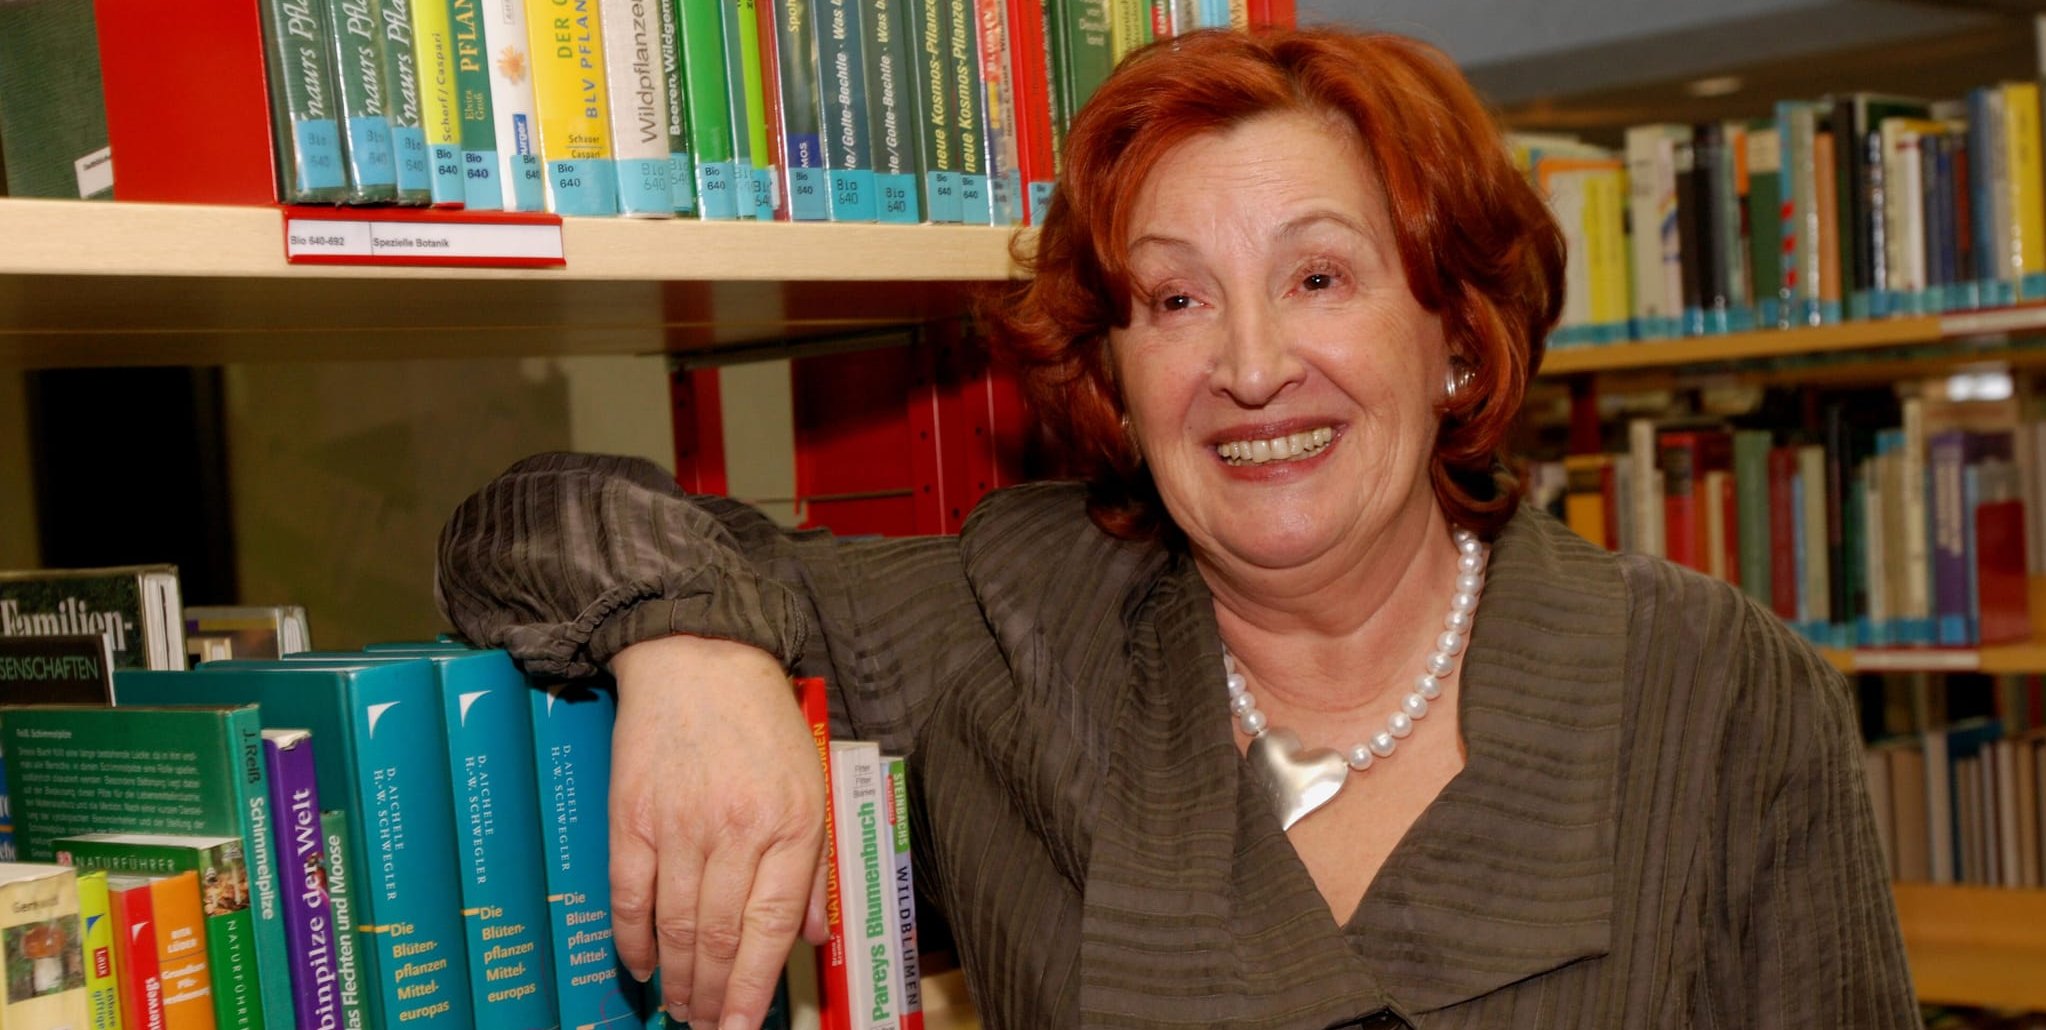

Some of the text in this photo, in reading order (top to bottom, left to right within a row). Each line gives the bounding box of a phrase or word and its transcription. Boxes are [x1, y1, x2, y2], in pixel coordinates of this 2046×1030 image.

[832, 9, 846, 40] Was
[877, 13, 889, 43] Was
[554, 17, 573, 59] DER
[432, 33, 446, 86] Caspari
[358, 46, 382, 118] naurs
[632, 0, 658, 144] Wildpflanze
[300, 47, 325, 121] naurs
[582, 78, 599, 118] BLV
[437, 149, 452, 159] Bio
[466, 153, 482, 163] Bio
[935, 129, 948, 170] neue
[962, 133, 976, 173] neue
[438, 165, 458, 175] 640
[467, 169, 489, 179] 640
[557, 164, 574, 173] Bio
[705, 167, 720, 176] Bio
[560, 178, 581, 188] 640
[707, 181, 726, 190] 640
[837, 178, 857, 191] Bio
[886, 187, 904, 198] Bio
[937, 187, 952, 196] 640
[839, 193, 858, 205] 640
[963, 190, 979, 199] 640
[887, 201, 906, 212] 640
[290, 236, 306, 245] Bio
[373, 238, 449, 248] Spezielle Botanik
[563, 745, 577, 823] D. AICHELE
[478, 755, 494, 836] D. AICHELE
[387, 768, 404, 850] D. AICHELE
[894, 772, 909, 846] STEINBACHS
[243, 729, 256, 743] J.
[250, 797, 274, 920] Schimmelpilze
[292, 788, 315, 856] Welt
[554, 785, 571, 871] SCHWEGLER
[469, 796, 487, 884] SCHWEGLER
[75, 855, 175, 870] NATURFÜHRER
[378, 810, 397, 900] SCHWEGLER
[857, 802, 884, 939] Blumenbuch
[303, 863, 321, 908] der
[563, 892, 585, 906] Die
[479, 905, 503, 920] Die
[566, 910, 607, 926] Blüten-
[328, 835, 361, 1030] as Flechten und Moose
[390, 922, 414, 937] Die
[482, 924, 525, 941] Blüten-
[896, 866, 918, 1006] WILDBLUMEN
[392, 941, 438, 958] Blüten-
[484, 942, 534, 964] pflanzen
[570, 947, 607, 967] Mittel-
[227, 920, 250, 1030] NATURFÜHRE
[395, 959, 447, 982] pflanzen
[486, 962, 526, 981] Mittel-
[571, 968, 617, 987] europas
[397, 980, 439, 1000] Mittel-
[871, 943, 890, 1022] Pareys
[488, 983, 536, 1003] europas
[400, 1001, 449, 1022] europas
